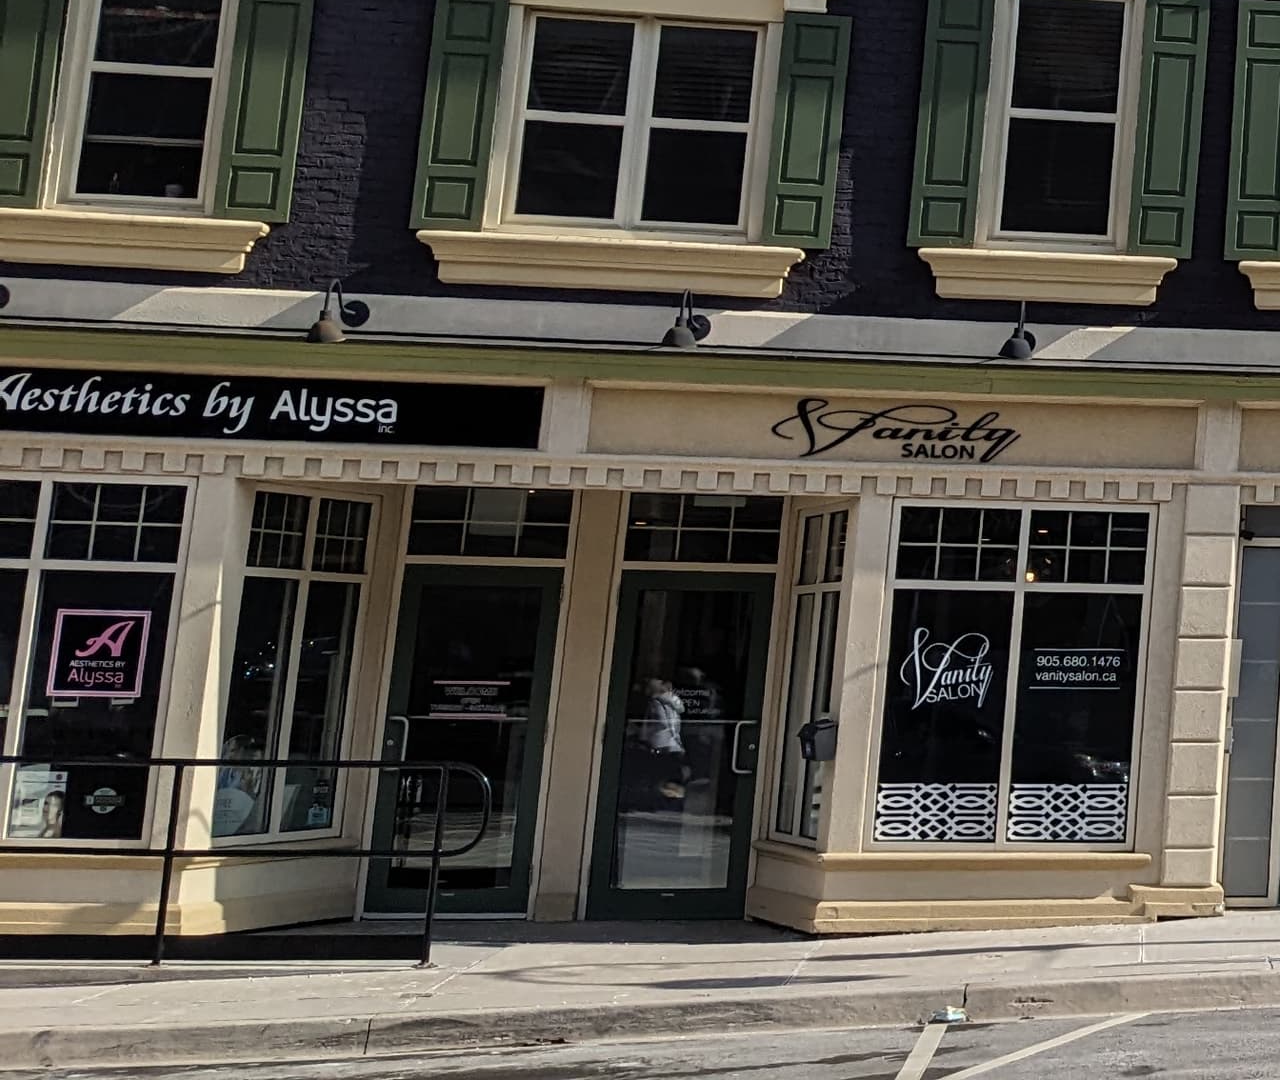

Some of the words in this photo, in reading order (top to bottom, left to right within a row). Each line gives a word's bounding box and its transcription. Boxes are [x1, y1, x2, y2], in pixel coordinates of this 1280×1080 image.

[0, 372, 191, 417] Aesthetics
[202, 381, 256, 434] by
[270, 388, 400, 432] Alyssa
[771, 398, 1022, 463] Vanity
[901, 443, 976, 459] SALON
[69, 659, 114, 668] AESTHETICS
[114, 660, 126, 668] BY
[900, 627, 994, 710] Vanity
[1036, 655, 1121, 668] 905.680.1476
[67, 668, 124, 688] Alyssa
[1035, 671, 1117, 683] vanitysalon.ca
[926, 682, 984, 704] SALON
